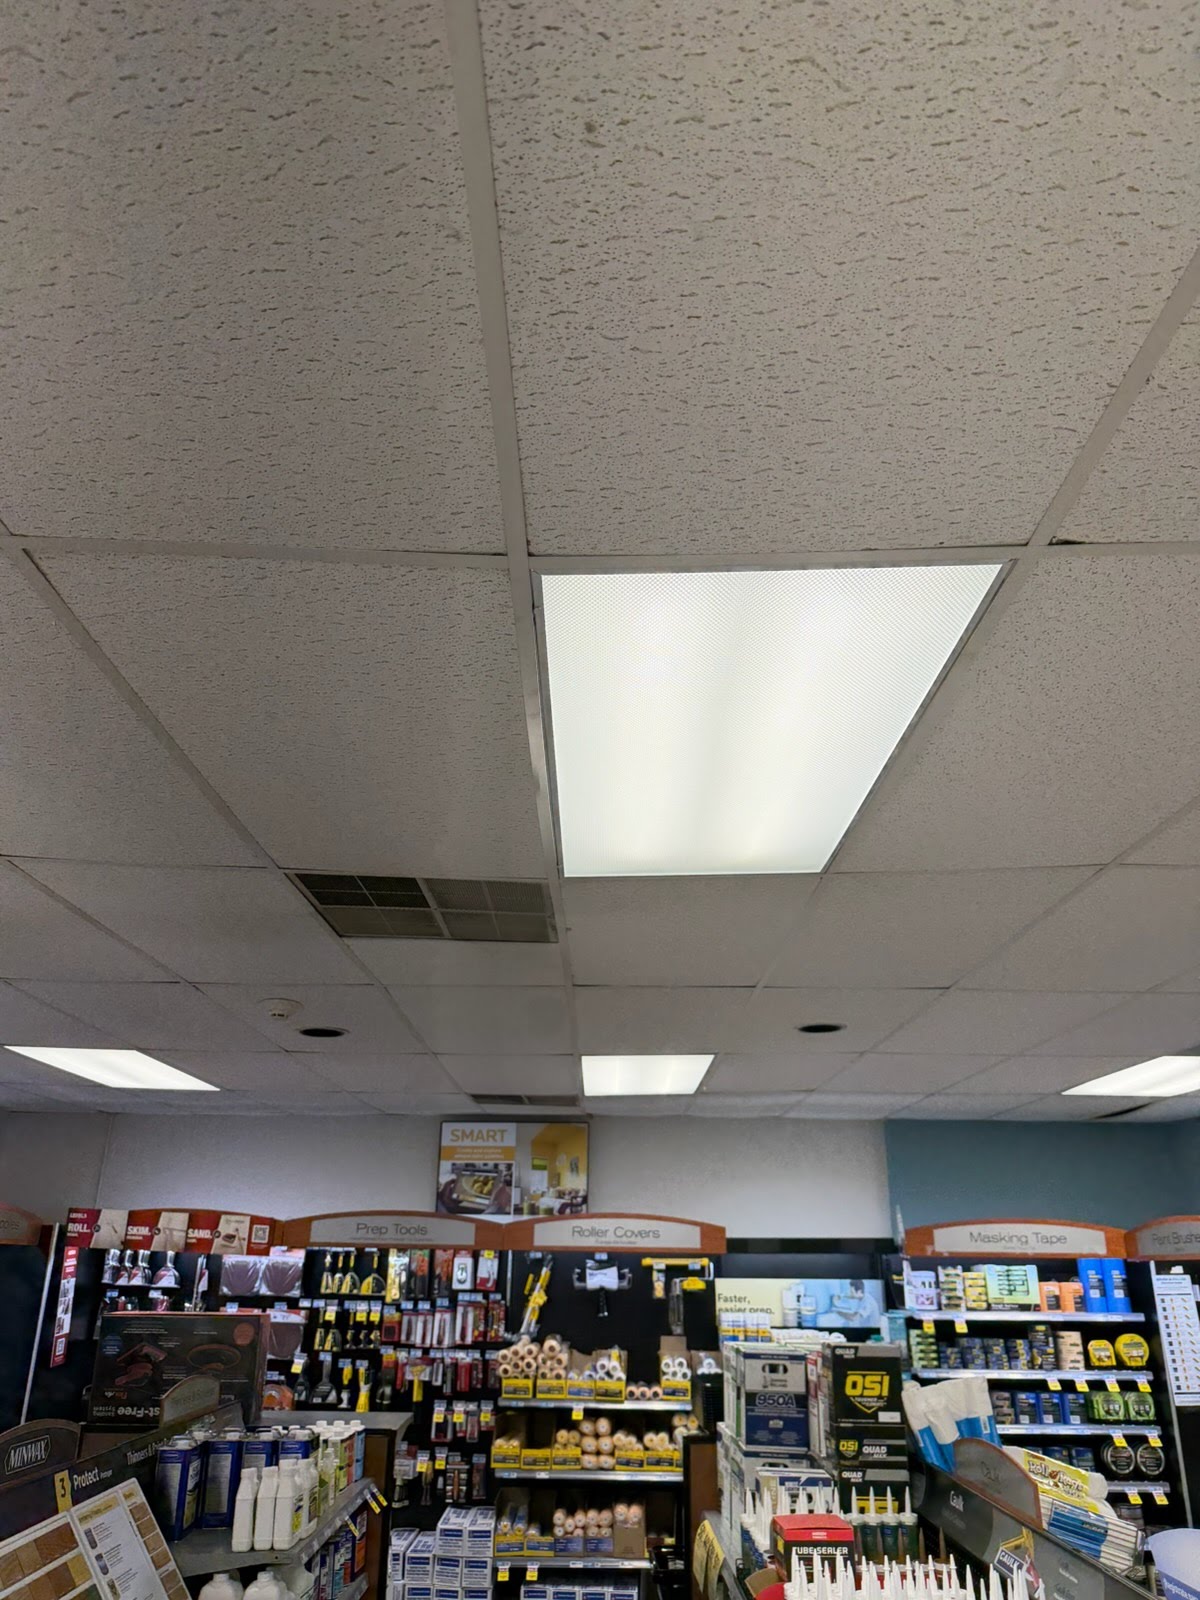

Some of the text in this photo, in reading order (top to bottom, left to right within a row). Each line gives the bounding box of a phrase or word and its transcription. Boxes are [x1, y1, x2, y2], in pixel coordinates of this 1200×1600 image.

[450, 1128, 507, 1142] SMART
[68, 1223, 91, 1233] ROLL.
[127, 1226, 151, 1235] SKIM.
[187, 1228, 213, 1239] SAND.
[356, 1222, 428, 1236] Prep Tools
[572, 1225, 660, 1239] Roller Covers
[969, 1231, 1067, 1245] Masking Tape
[717, 1293, 751, 1304] Faster,
[845, 1374, 890, 1397] OSI
[756, 1393, 796, 1408] 950A
[839, 1440, 858, 1451] OSI
[862, 1445, 887, 1454] QUAD
[8, 1440, 47, 1470] MINWAX
[73, 1466, 99, 1490] Protect
[60, 1477, 67, 1498] 3
[792, 1546, 849, 1555] TUBE SEALER
